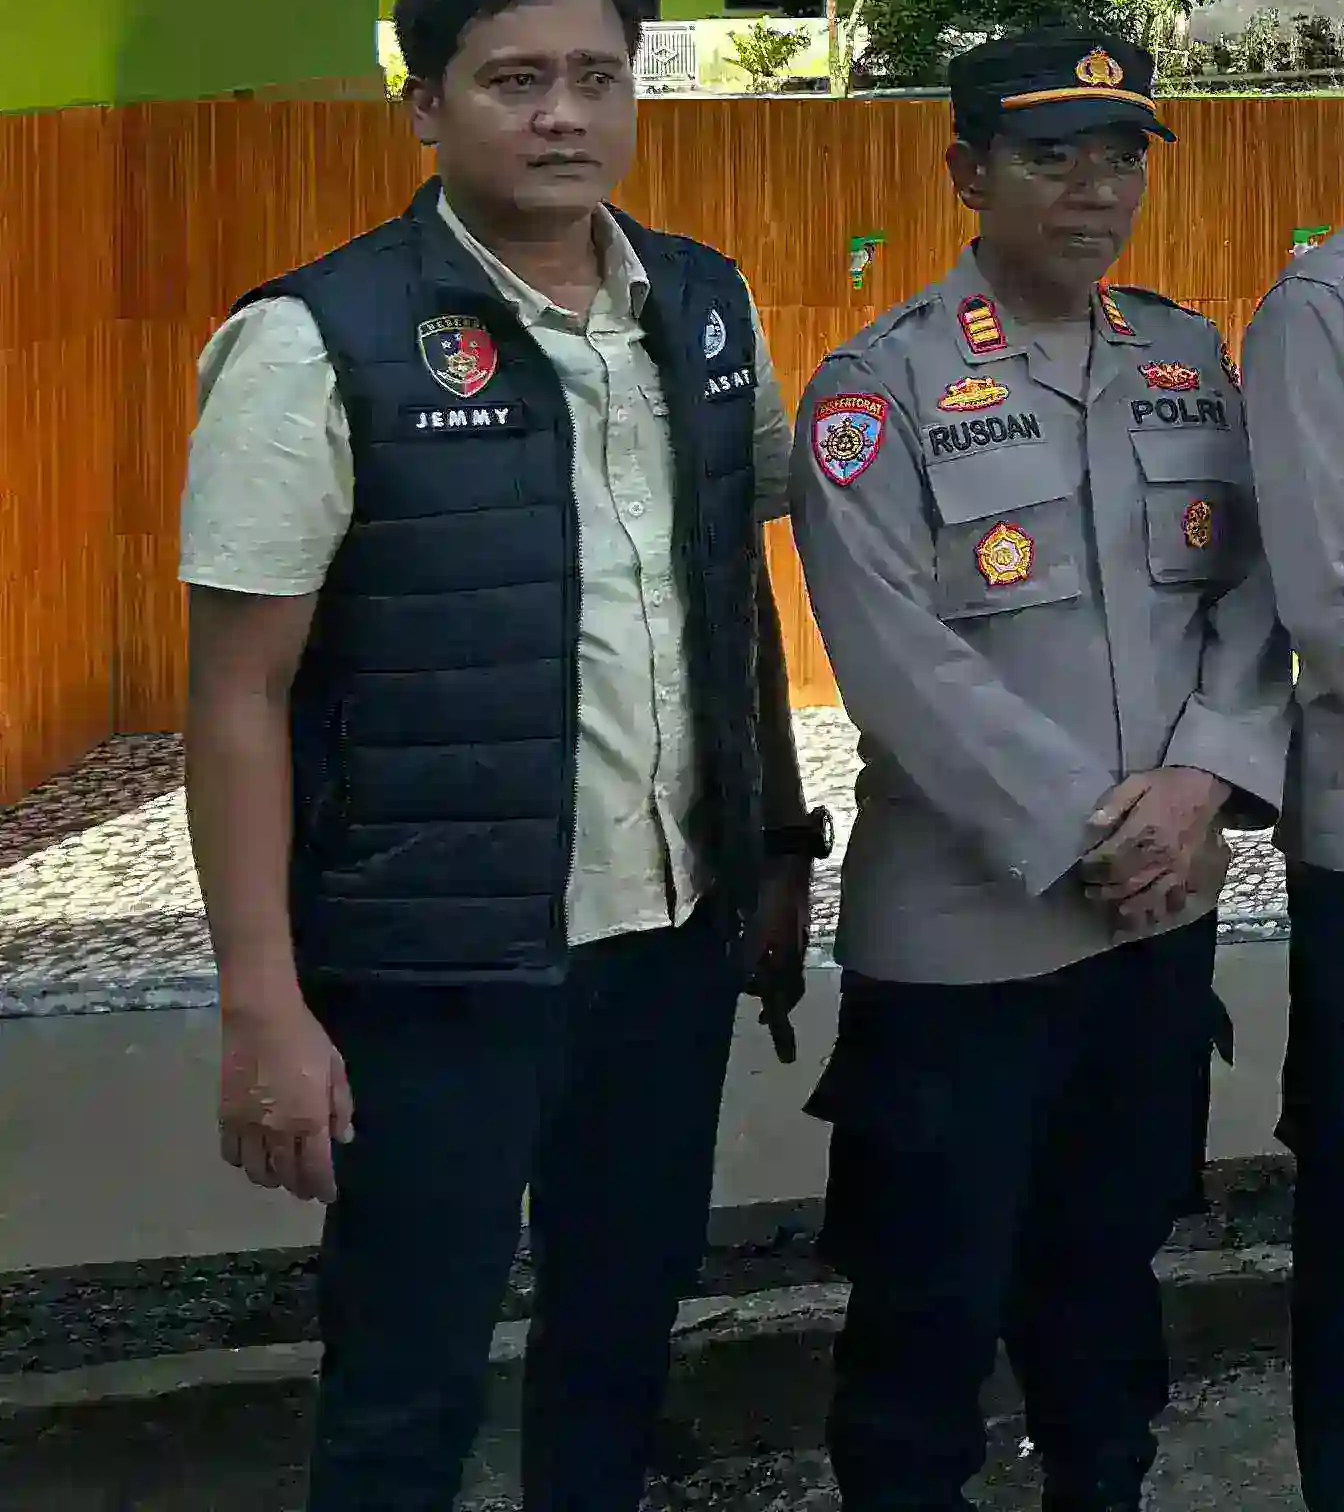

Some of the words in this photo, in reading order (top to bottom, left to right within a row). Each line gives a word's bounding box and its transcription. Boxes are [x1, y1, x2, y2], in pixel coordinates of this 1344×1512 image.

[704, 369, 750, 398] ASAT
[416, 408, 509, 428] JEMMY
[1130, 396, 1226, 426] POLRI
[928, 412, 1042, 456] RUSDAN
